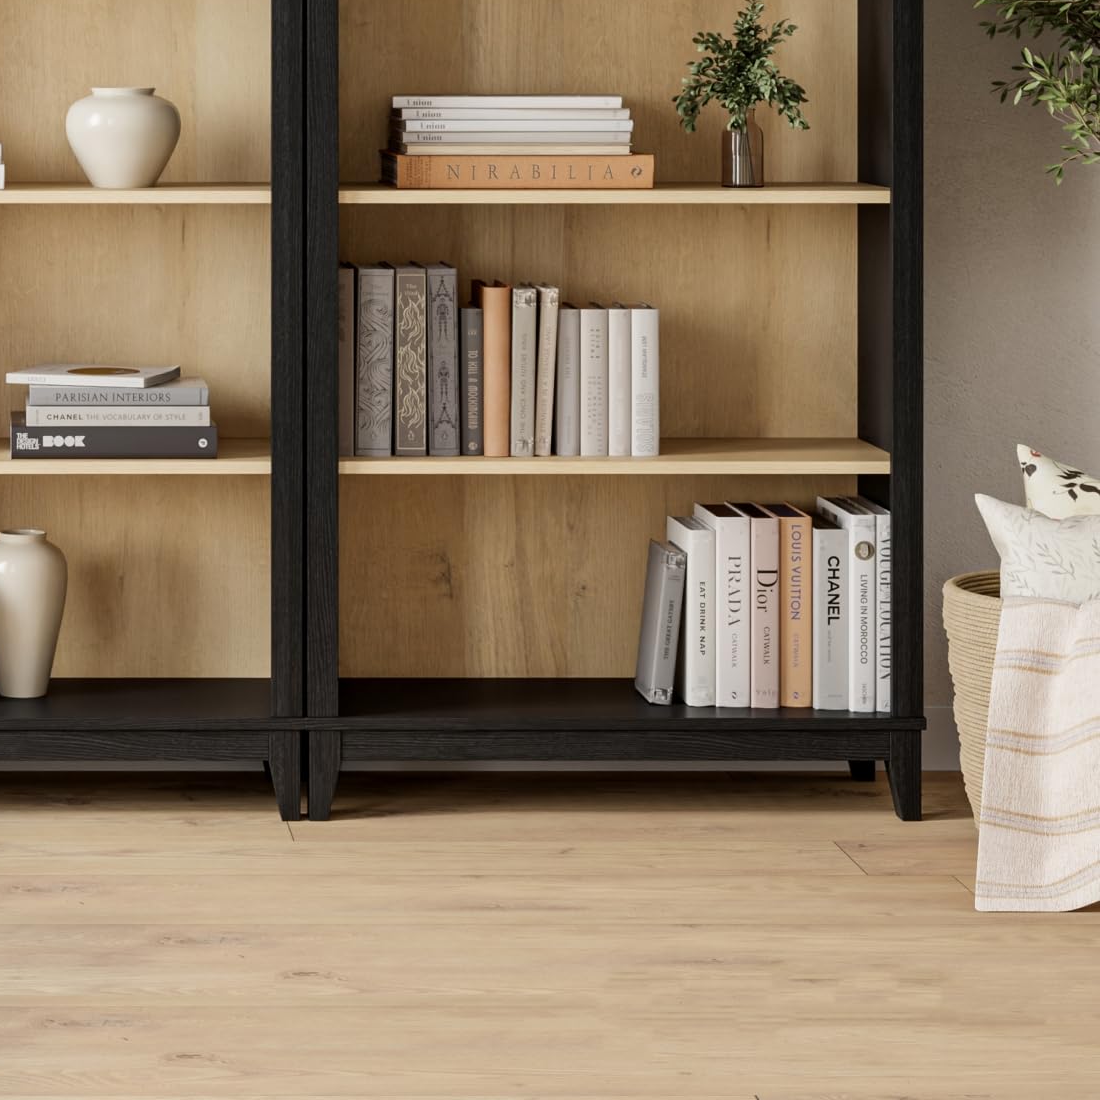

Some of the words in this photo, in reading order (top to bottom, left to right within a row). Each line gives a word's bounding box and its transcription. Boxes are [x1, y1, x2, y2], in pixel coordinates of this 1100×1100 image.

[447, 164, 614, 180] NIRABILIA
[467, 349, 478, 358] TO
[467, 361, 478, 375] KILL
[55, 392, 108, 402] PARISIAN
[112, 392, 171, 402] INTERIORS
[467, 385, 478, 429] MOCKINGBIRD
[46, 413, 83, 421] CHANEL
[103, 413, 150, 421] VOCABULARY
[153, 413, 163, 421] OF
[165, 413, 186, 421] STYLE
[42, 435, 86, 447] BOOK
[790, 524, 801, 563] LOUIS
[727, 556, 742, 627] PRADA
[756, 569, 778, 613] Dior
[790, 566, 802, 621] VUITTON
[827, 555, 840, 626] CHANEL
[860, 574, 868, 604] LIVING
[860, 606, 868, 614] IN
[860, 615, 868, 664] MOROCCO
